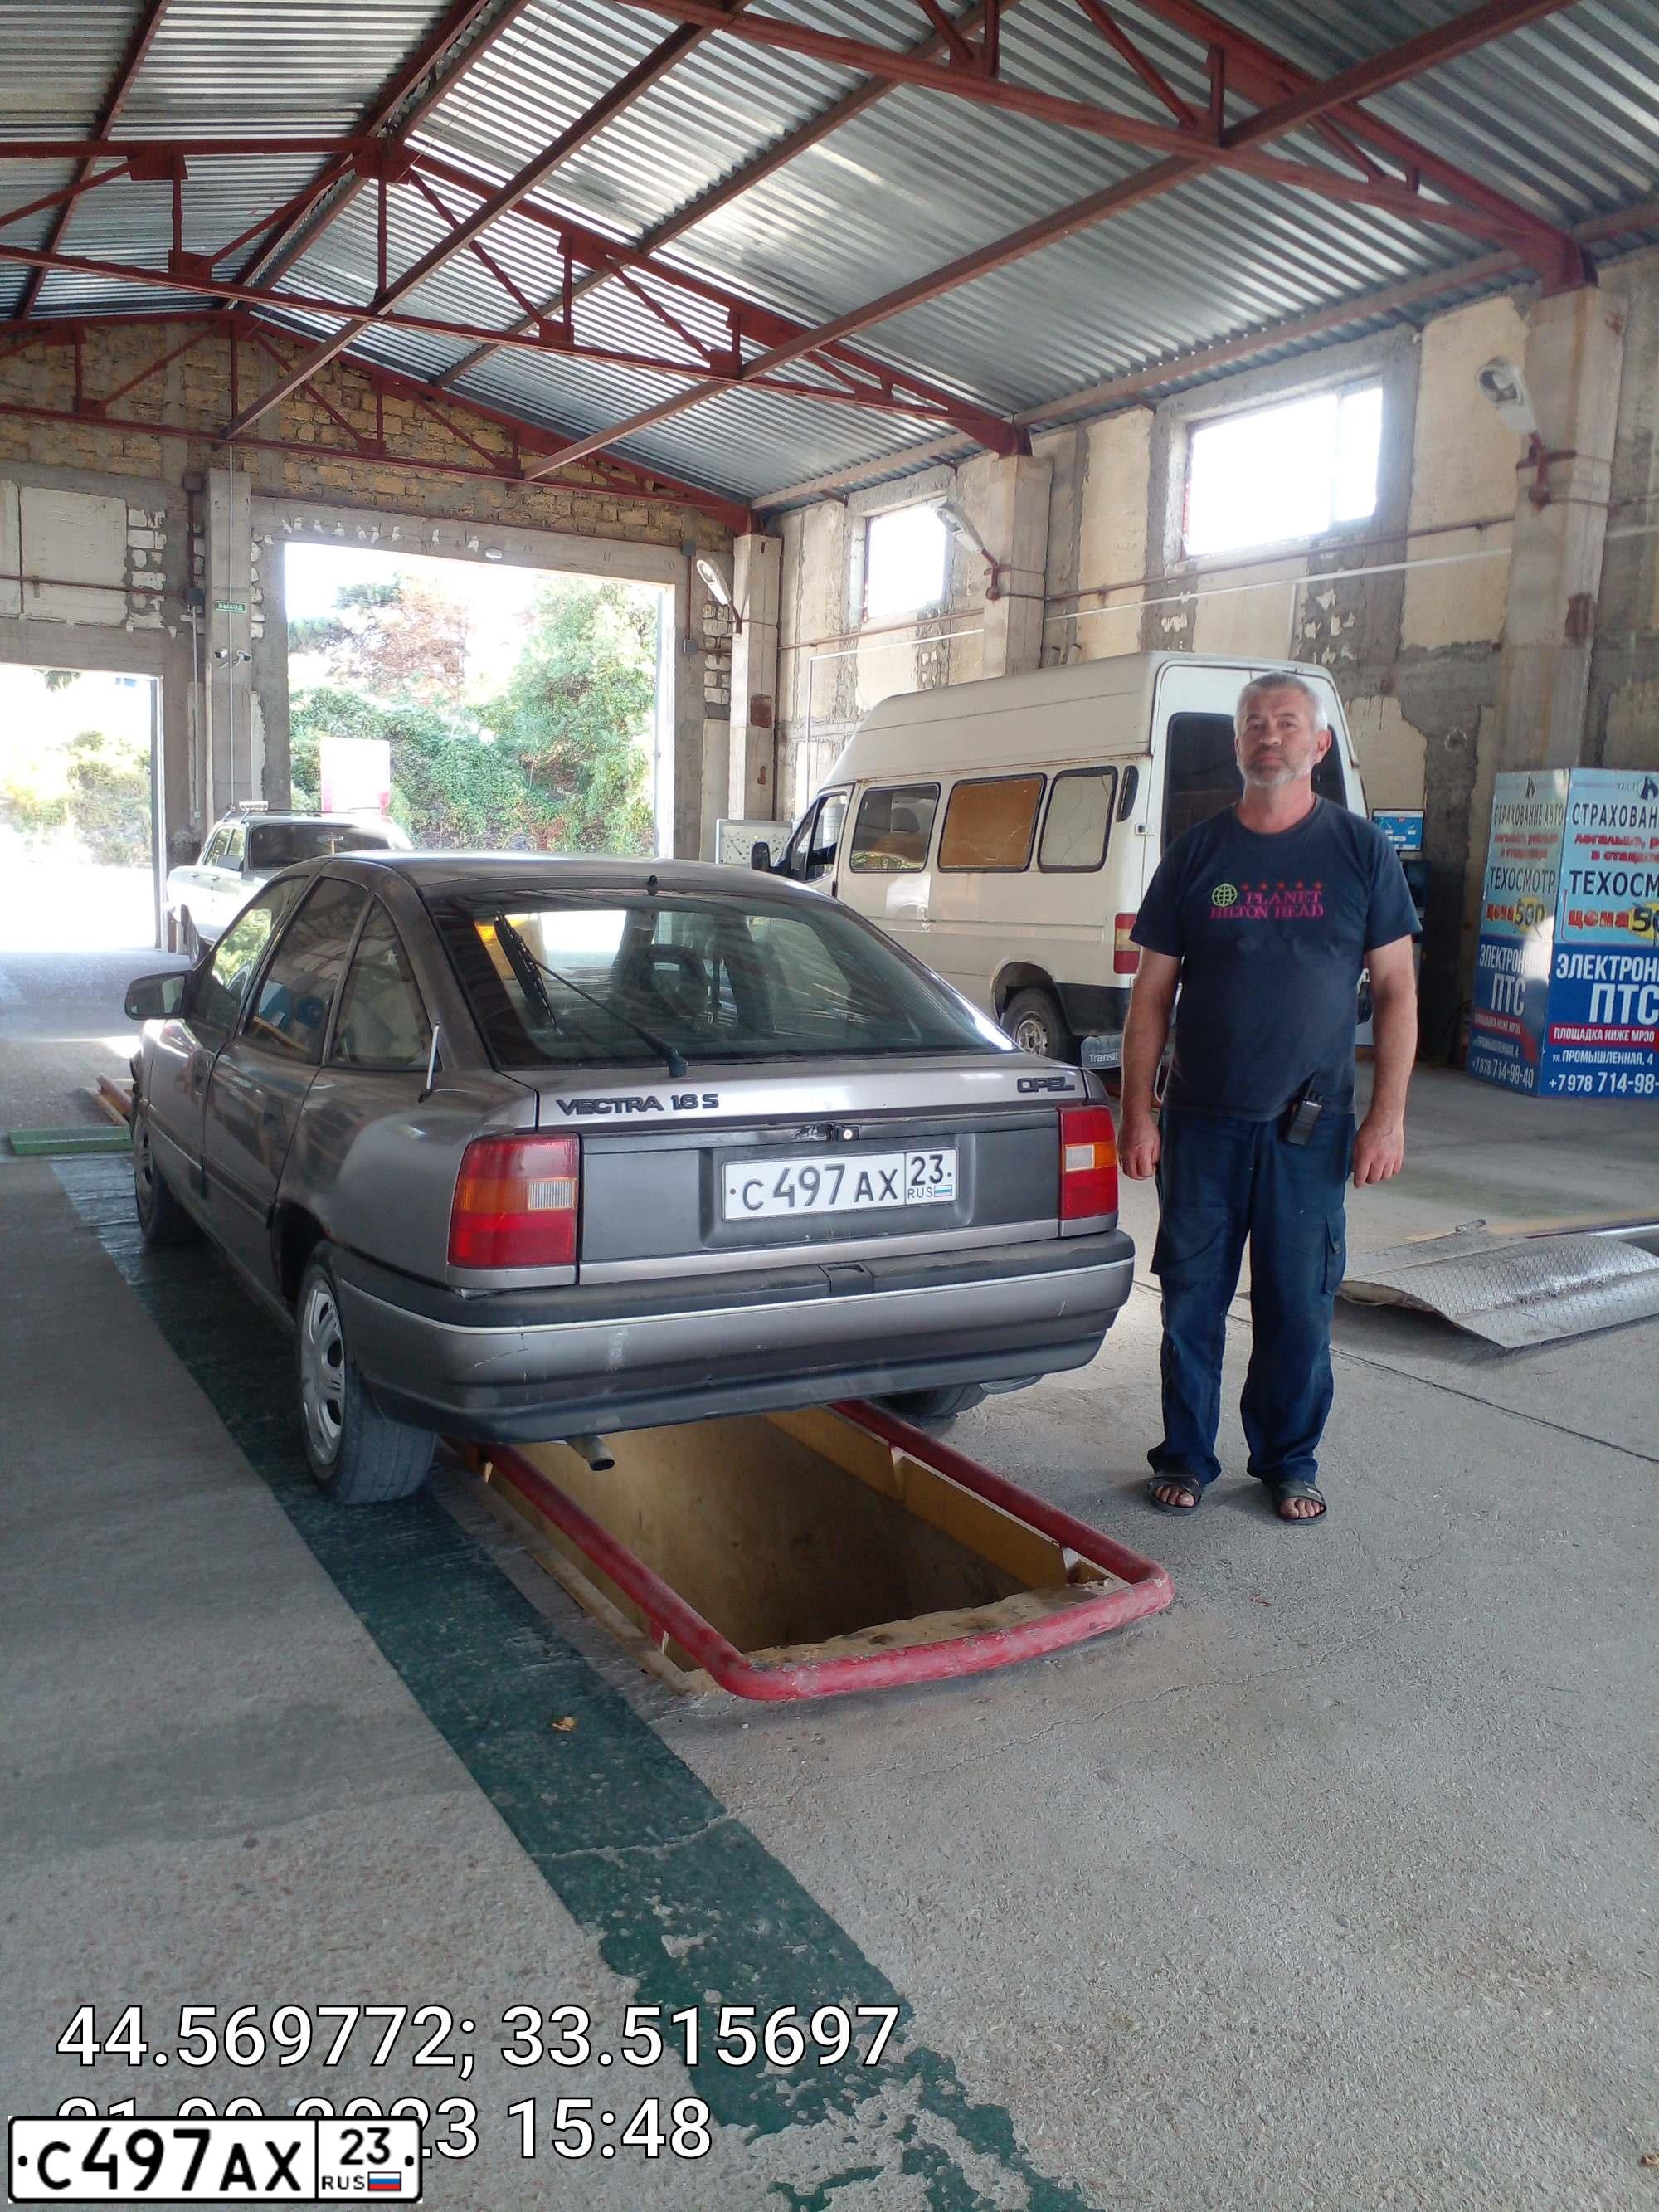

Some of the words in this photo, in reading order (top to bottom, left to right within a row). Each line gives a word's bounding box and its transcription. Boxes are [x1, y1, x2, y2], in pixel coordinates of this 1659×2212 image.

[1494, 802, 1542, 826] СТРАХОВАНИЕ
[1544, 803, 1564, 826] АВТО
[1572, 802, 1659, 828] СТРАХОВАН
[1490, 867, 1556, 894] ТЕХОСМОТР
[1569, 870, 1659, 898] ТЕХОСМ
[1245, 889, 1323, 905] PLANET
[1210, 905, 1268, 919] HILTON
[1273, 904, 1325, 918] HEAD
[1556, 953, 1659, 982] ЭЛЕКТРОН
[1491, 972, 1526, 1016] ПТС
[1588, 982, 1659, 1026] ПТС
[1554, 1027, 1603, 1041] ПЛОЩАДКА
[1604, 1029, 1630, 1041] НИЖЕ
[1631, 1030, 1655, 1043] МРЭО
[1088, 1052, 1119, 1063] Transit
[1647, 1052, 1654, 1065] 4
[1017, 1077, 1076, 1093] OPEL
[1492, 1058, 1535, 1089] 714-98-40
[556, 1095, 664, 1116] VECTRA
[910, 1154, 945, 1186] 23
[907, 1186, 934, 1199] RUS
